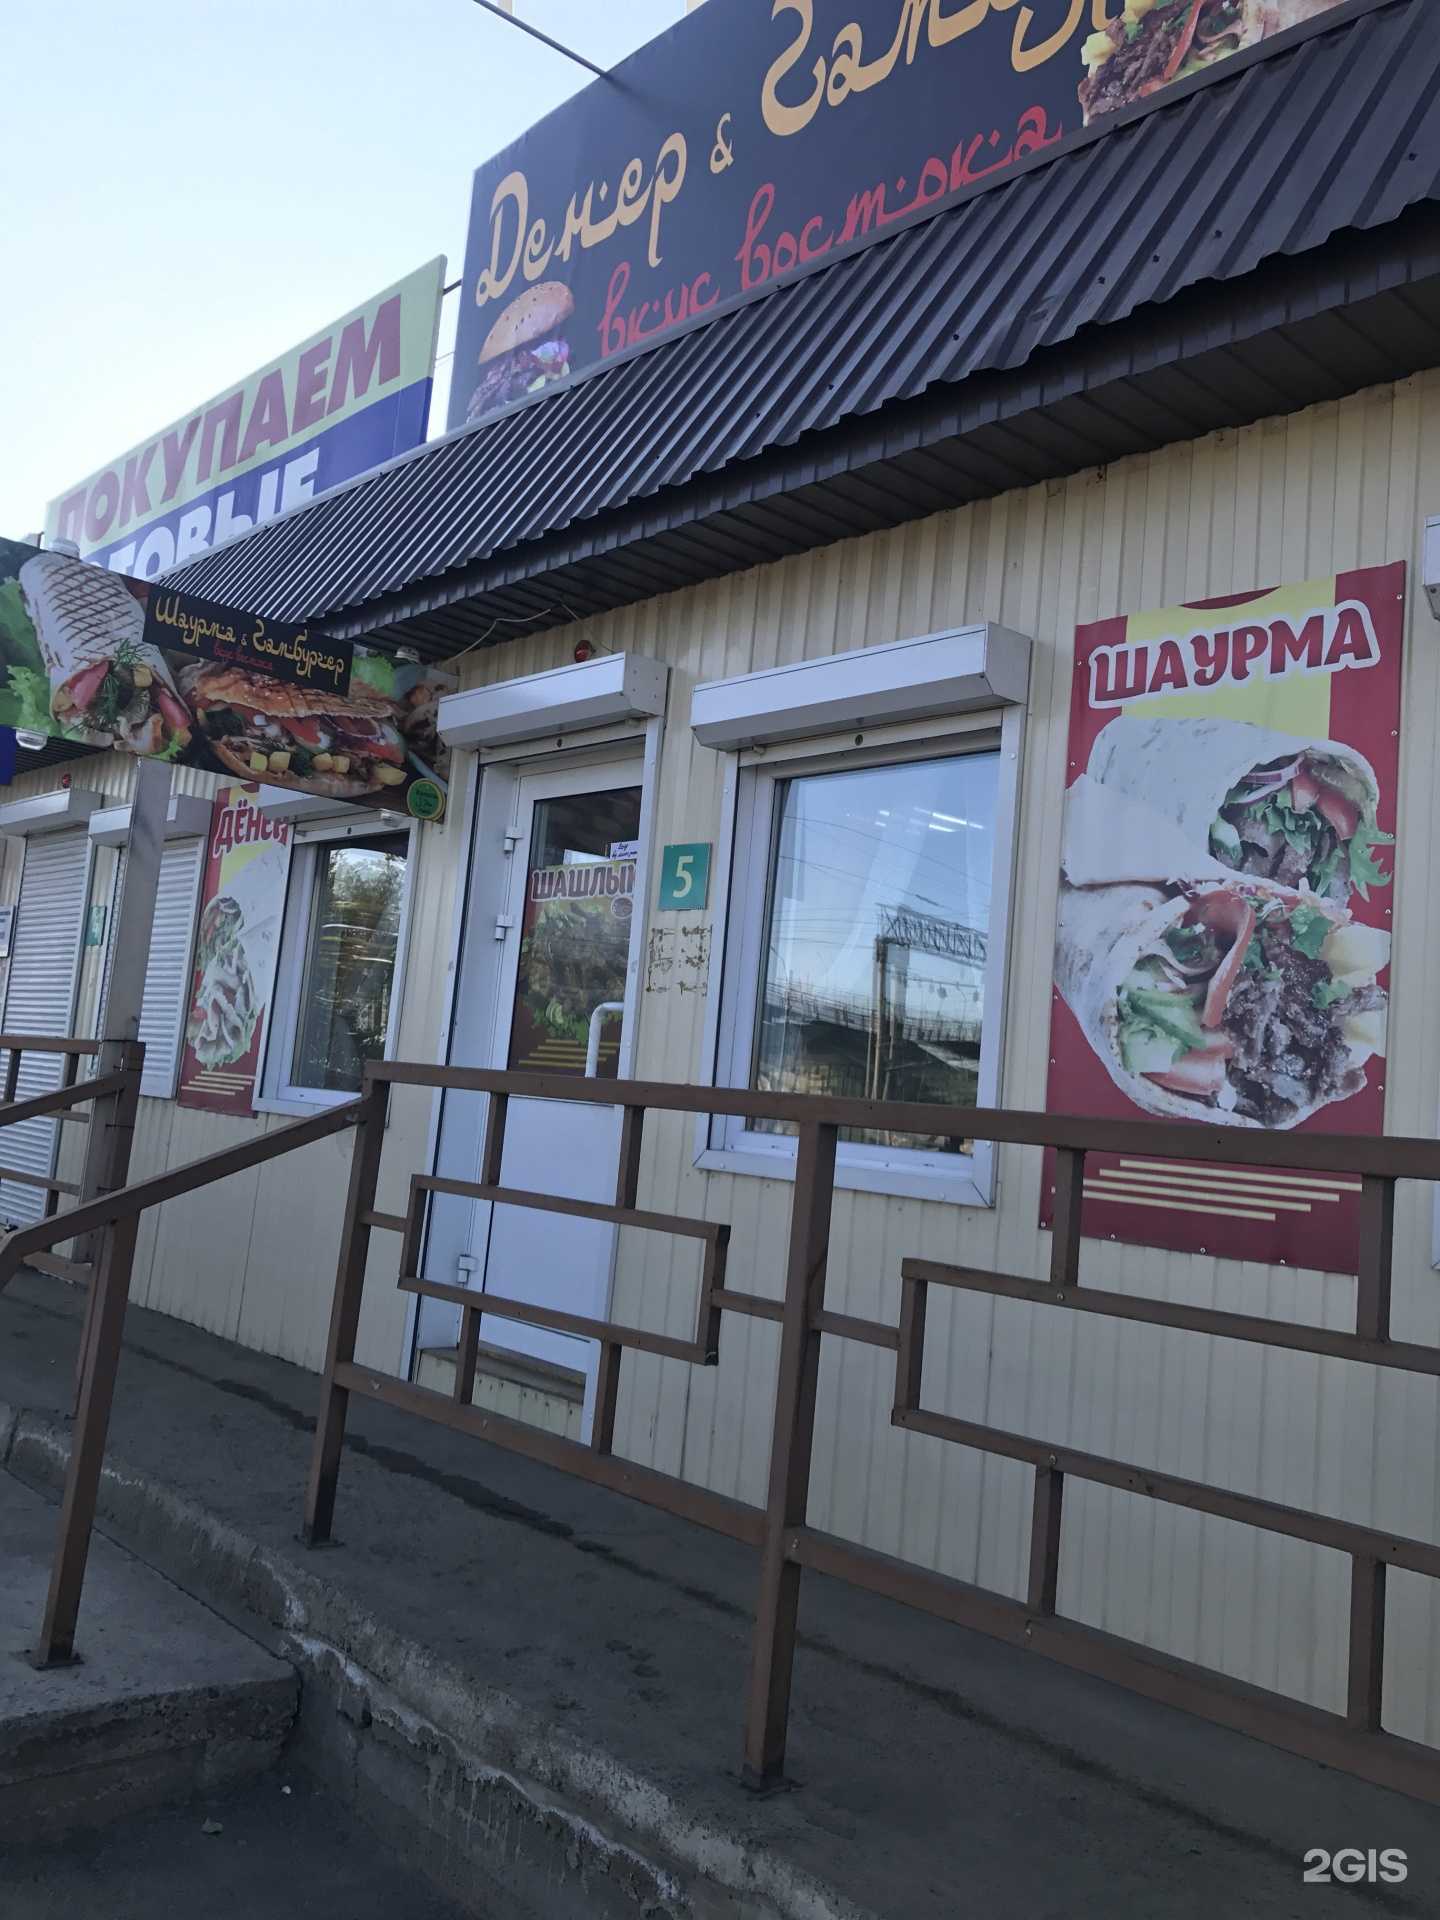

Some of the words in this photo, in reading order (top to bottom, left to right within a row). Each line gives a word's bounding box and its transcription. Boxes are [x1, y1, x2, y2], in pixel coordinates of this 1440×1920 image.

[475, 132, 687, 308] Денер
[709, 112, 734, 174] &
[57, 292, 402, 543] ПОКУПАЕМ
[155, 595, 236, 647] Шаурма
[252, 618, 345, 685] Гамбургер
[1092, 606, 1374, 703] ШАУРМА
[672, 855, 694, 898] 5
